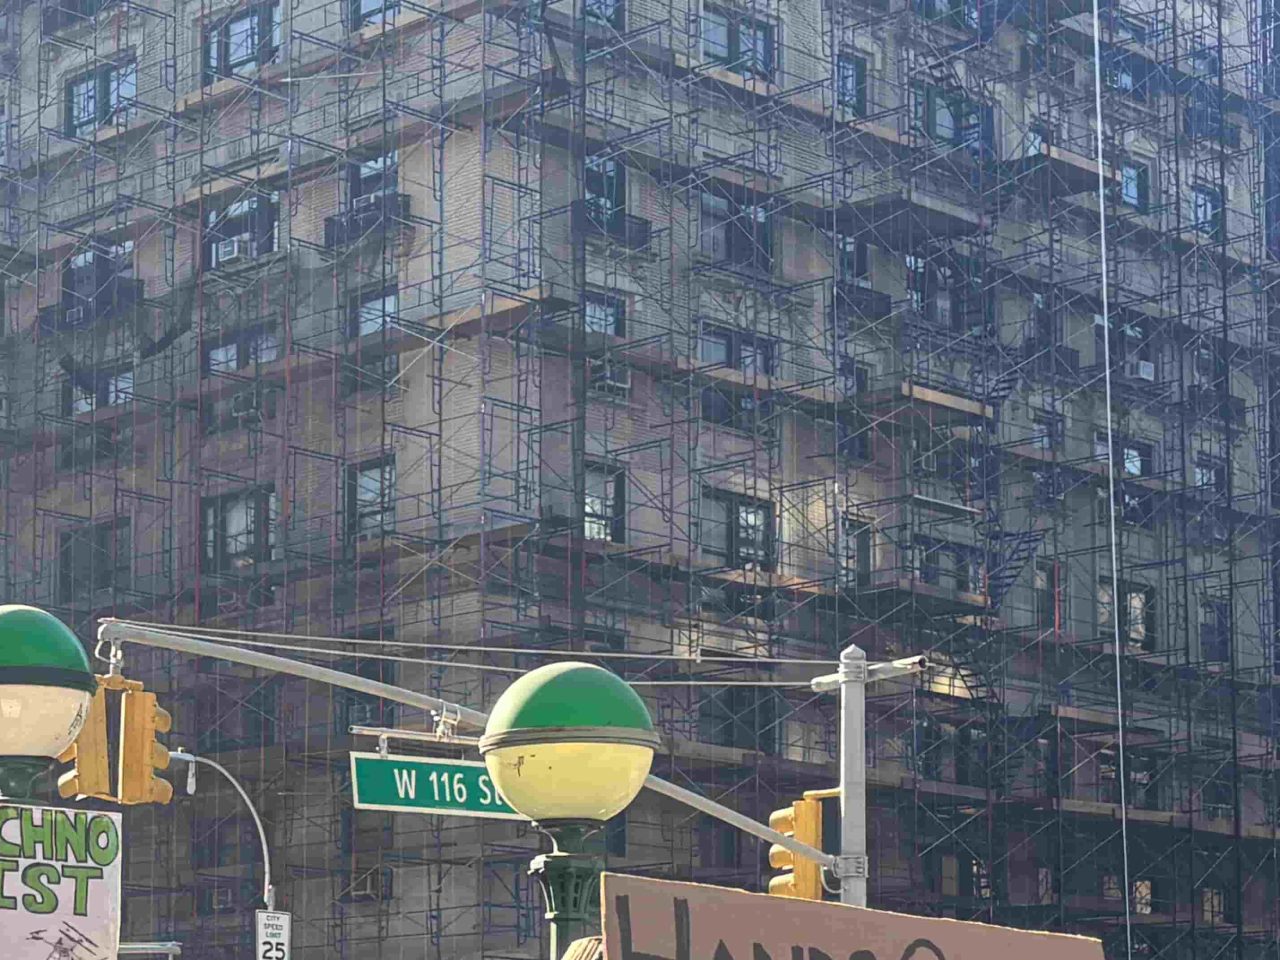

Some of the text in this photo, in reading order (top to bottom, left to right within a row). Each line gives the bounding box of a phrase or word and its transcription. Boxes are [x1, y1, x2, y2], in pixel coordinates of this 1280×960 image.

[394, 768, 417, 800] W
[429, 772, 467, 803] 116
[263, 922, 284, 931] SPEED
[262, 941, 286, 960] 25
